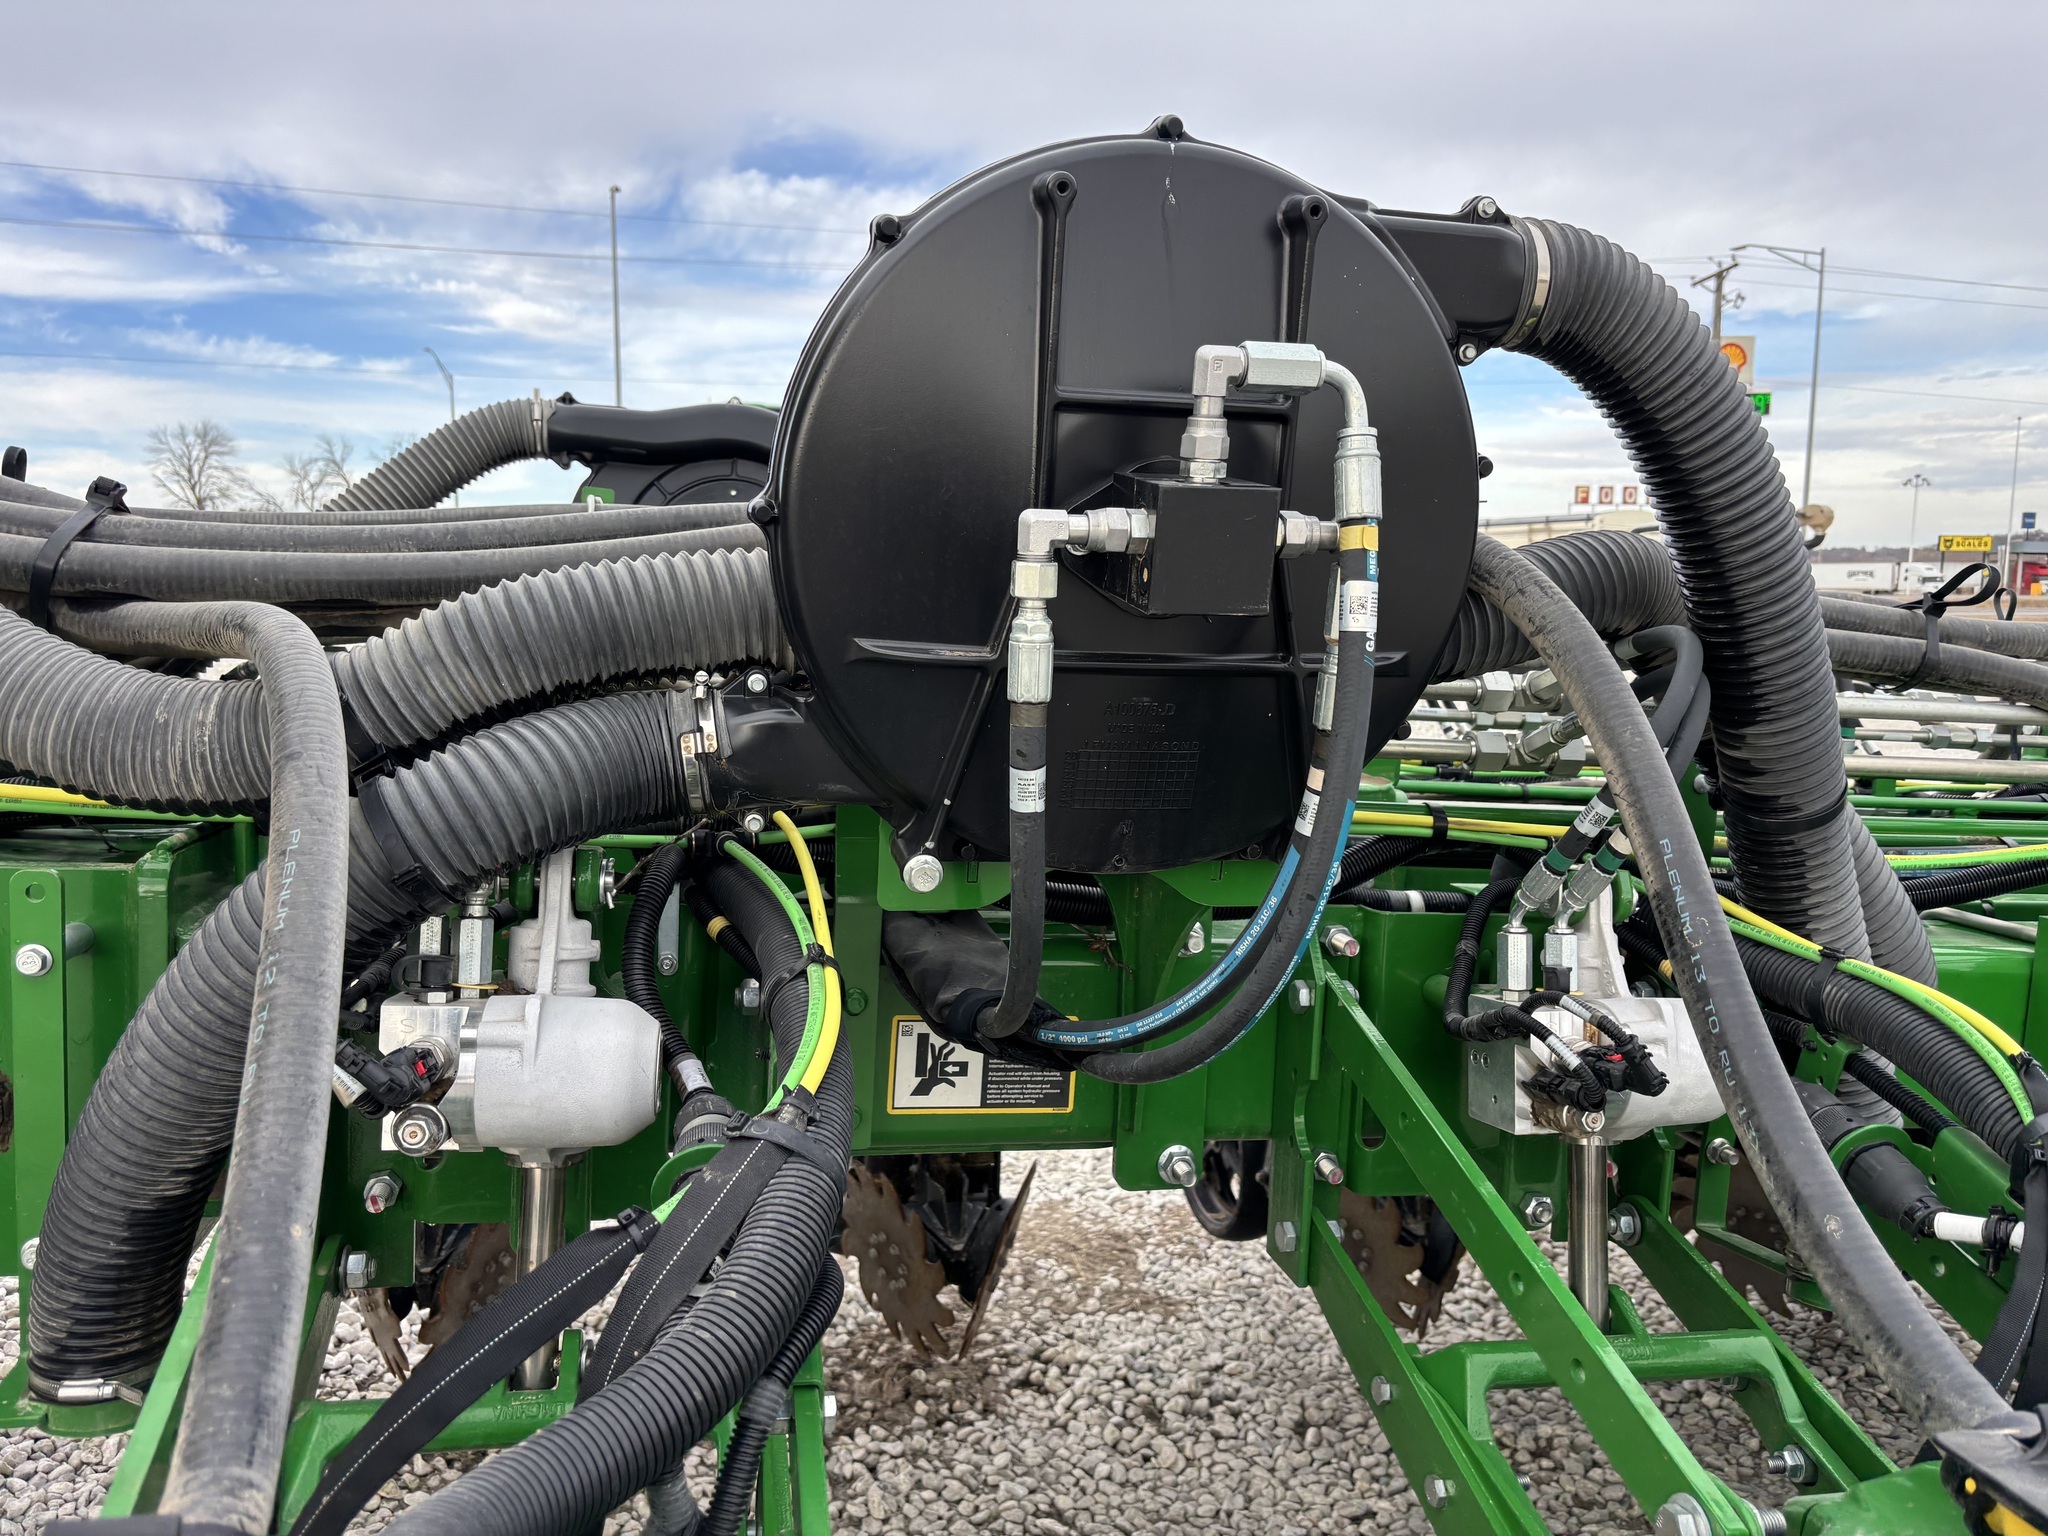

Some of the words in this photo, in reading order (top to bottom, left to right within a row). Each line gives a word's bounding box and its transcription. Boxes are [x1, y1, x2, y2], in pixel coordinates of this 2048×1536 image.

[1576, 486, 1650, 504] FOO
[1108, 723, 1135, 733] MADE
[273, 828, 300, 931] PLENUM
[1305, 913, 1322, 940] MSHA
[1235, 935, 1254, 958] MSHA
[1658, 838, 1692, 935] PLENUM
[1689, 952, 1707, 982] 13
[1704, 1000, 1720, 1035] TO
[1718, 1049, 1737, 1087] RU
[253, 1003, 270, 1044] TO
[400, 1018, 415, 1034] S
[1150, 1014, 1172, 1028] Performance
[1040, 1032, 1056, 1041] 1/2"
[1058, 1034, 1075, 1043] 4000
[1077, 1034, 1088, 1044] psi
